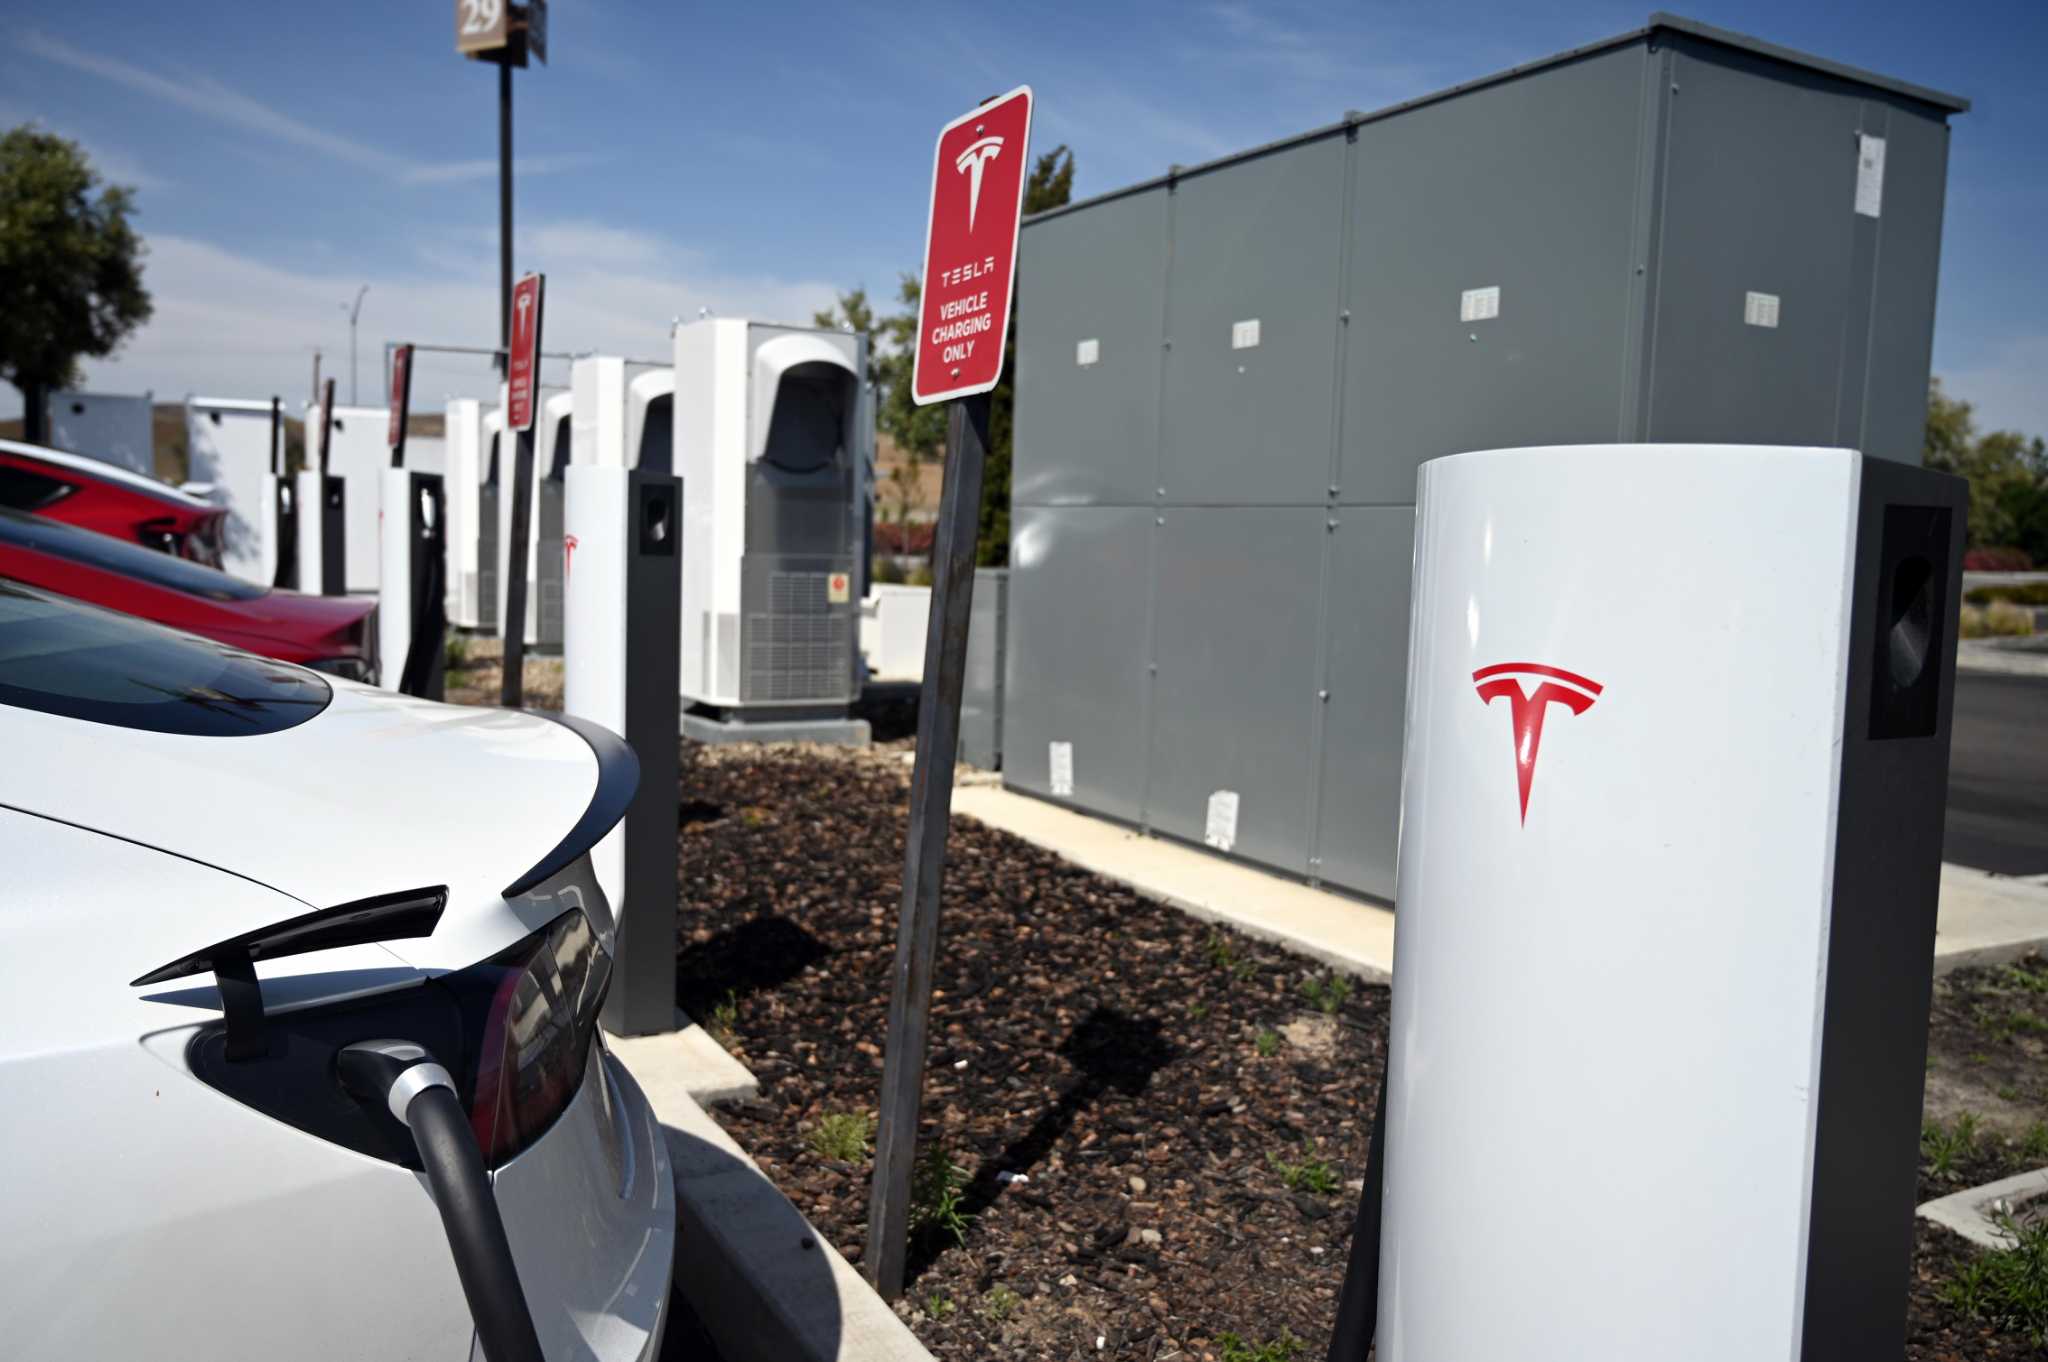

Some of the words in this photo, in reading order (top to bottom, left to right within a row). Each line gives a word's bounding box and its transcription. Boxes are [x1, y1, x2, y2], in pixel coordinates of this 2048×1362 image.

[463, 0, 500, 34] 29
[941, 256, 995, 288] TESLA
[940, 291, 988, 321] VEHICLE
[932, 313, 992, 345] CHARGING
[943, 340, 975, 364] ONLY
